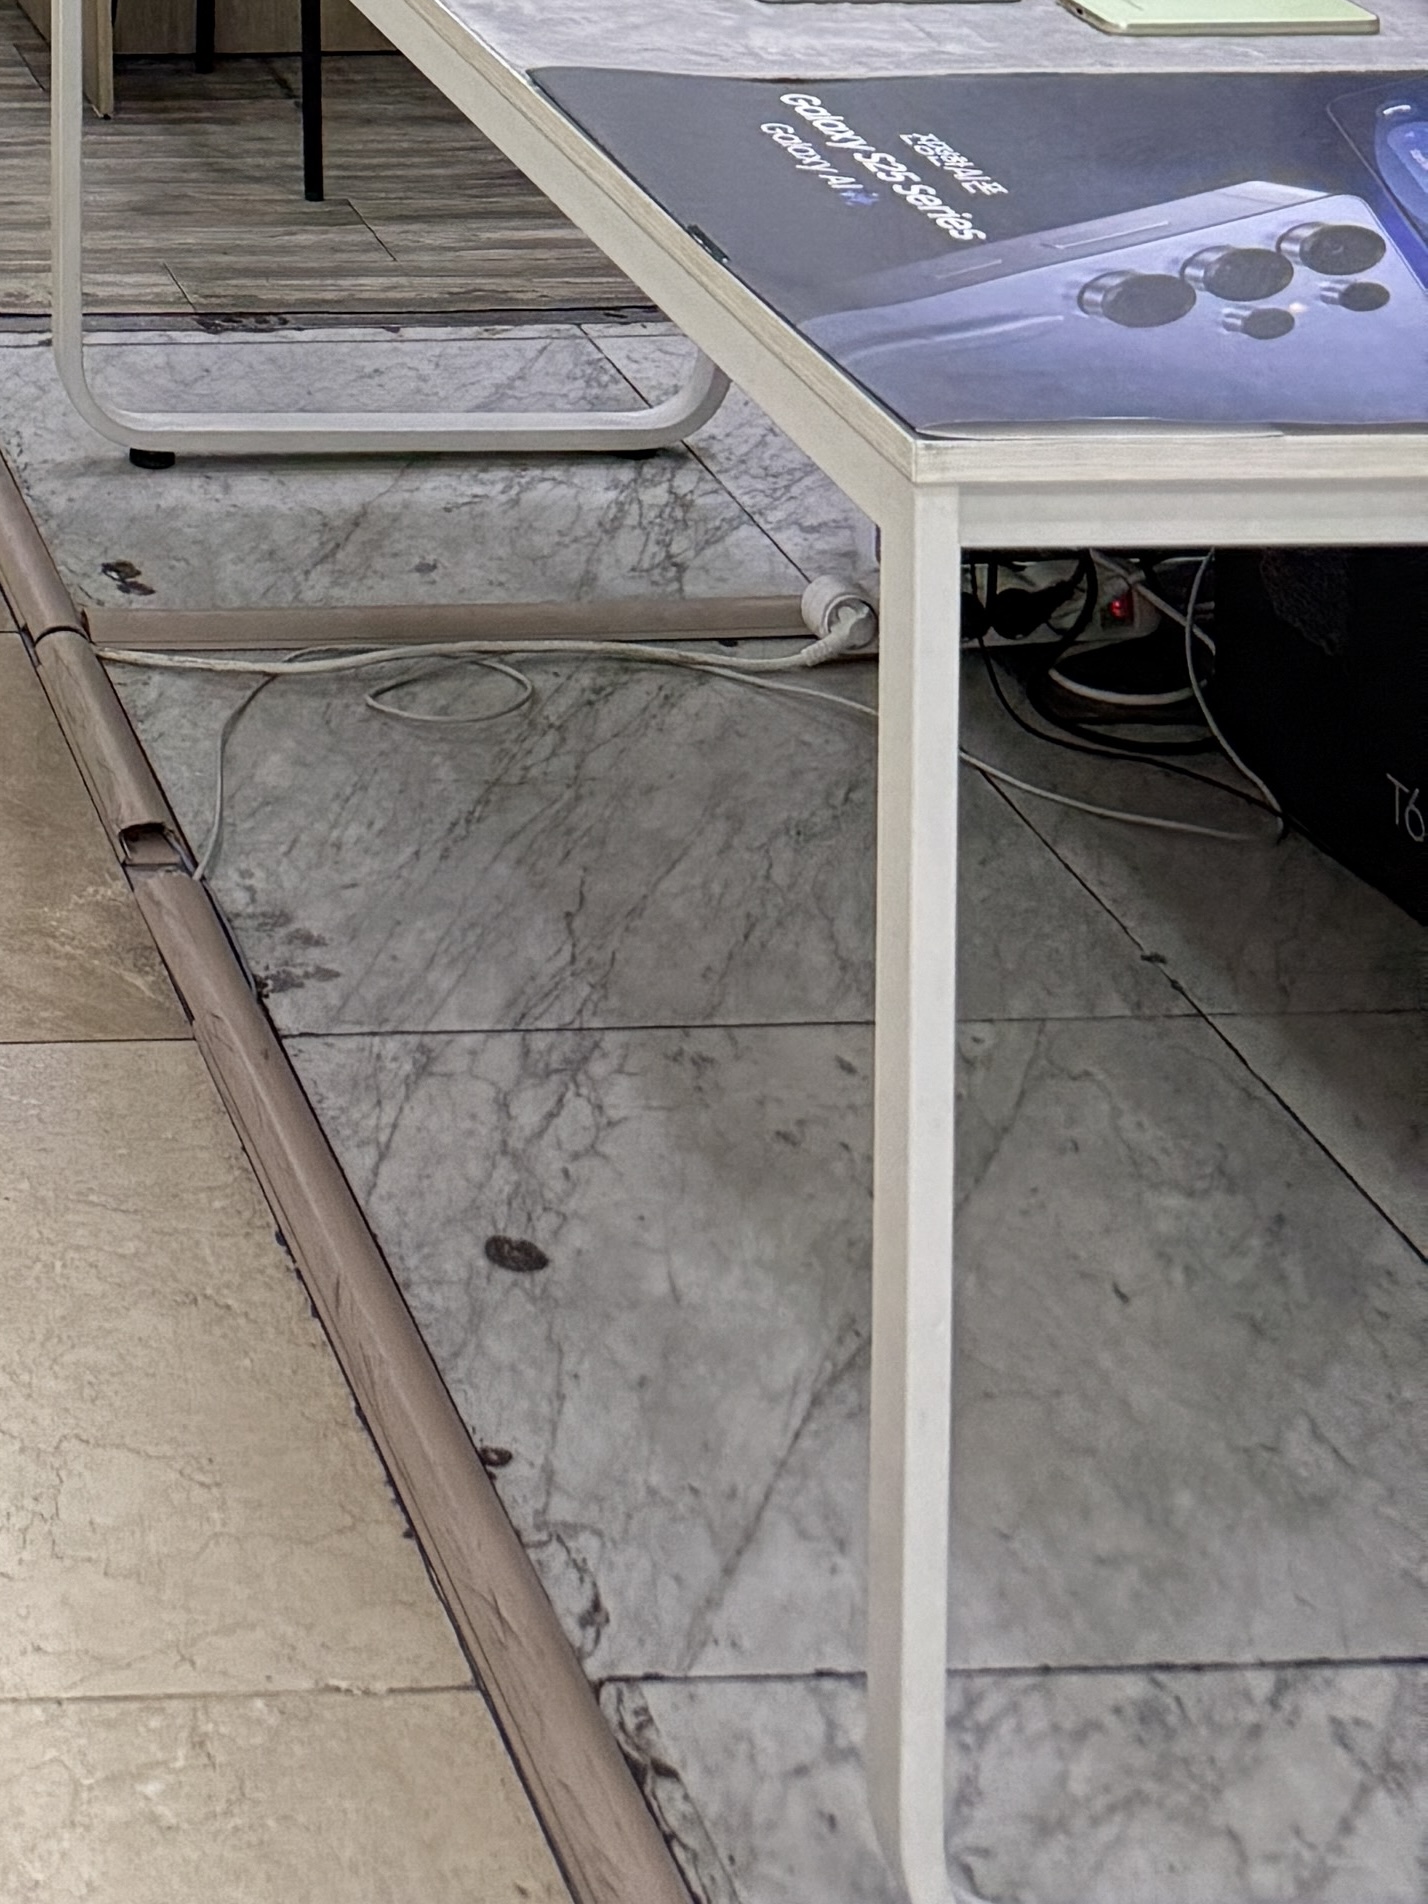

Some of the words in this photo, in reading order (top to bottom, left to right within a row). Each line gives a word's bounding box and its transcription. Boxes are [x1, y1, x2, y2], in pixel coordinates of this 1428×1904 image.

[759, 122, 839, 174] Galaxy
[818, 174, 864, 190] AI
[779, 92, 876, 151] Galaxy
[853, 152, 921, 183] S25
[892, 183, 987, 241] Series
